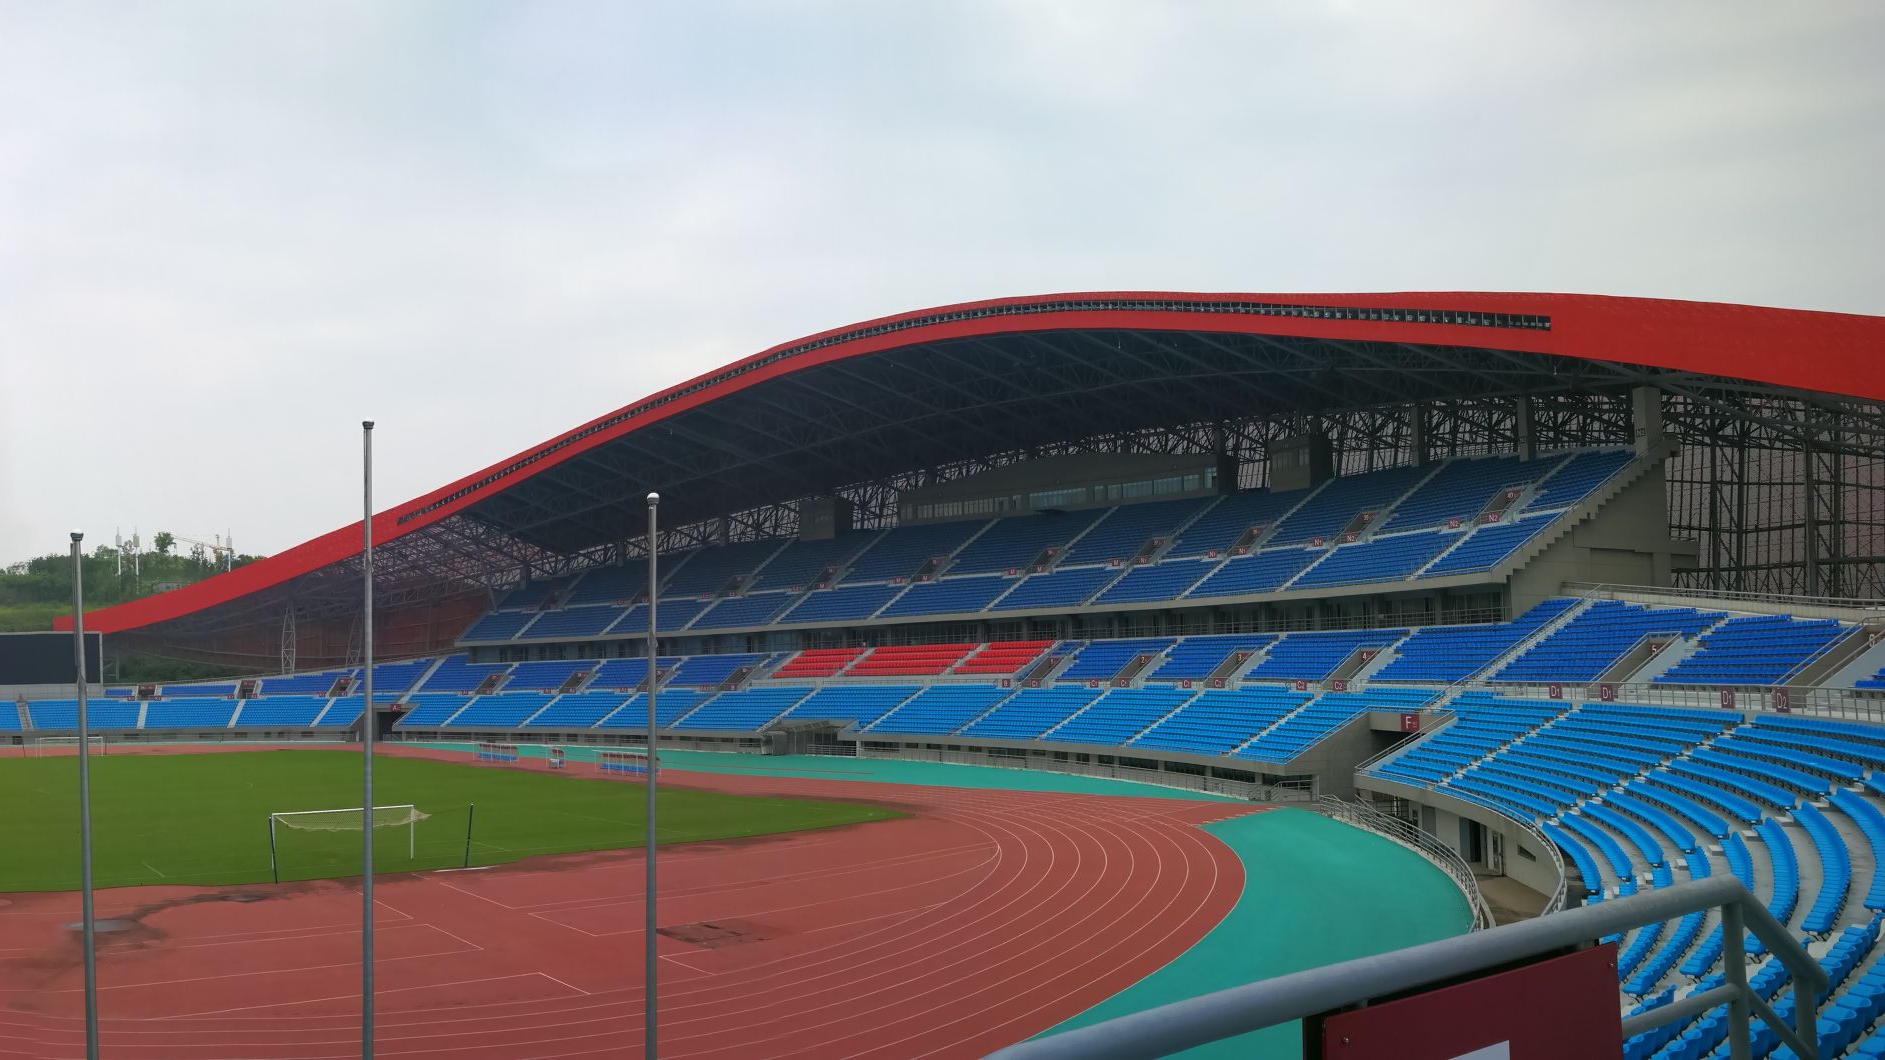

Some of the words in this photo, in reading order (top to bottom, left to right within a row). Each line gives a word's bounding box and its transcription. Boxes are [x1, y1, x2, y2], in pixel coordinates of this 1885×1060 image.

[1488, 513, 1498, 522] N2
[1449, 519, 1459, 527] N2
[1314, 538, 1322, 546] N1
[1362, 652, 1367, 661] 4
[1297, 680, 1305, 689] C2
[1334, 681, 1343, 690] C2
[1550, 685, 1560, 697] D1
[1602, 686, 1612, 699] D1
[1722, 690, 1732, 705] D1
[1776, 692, 1787, 709] D2
[1405, 716, 1412, 729] F
